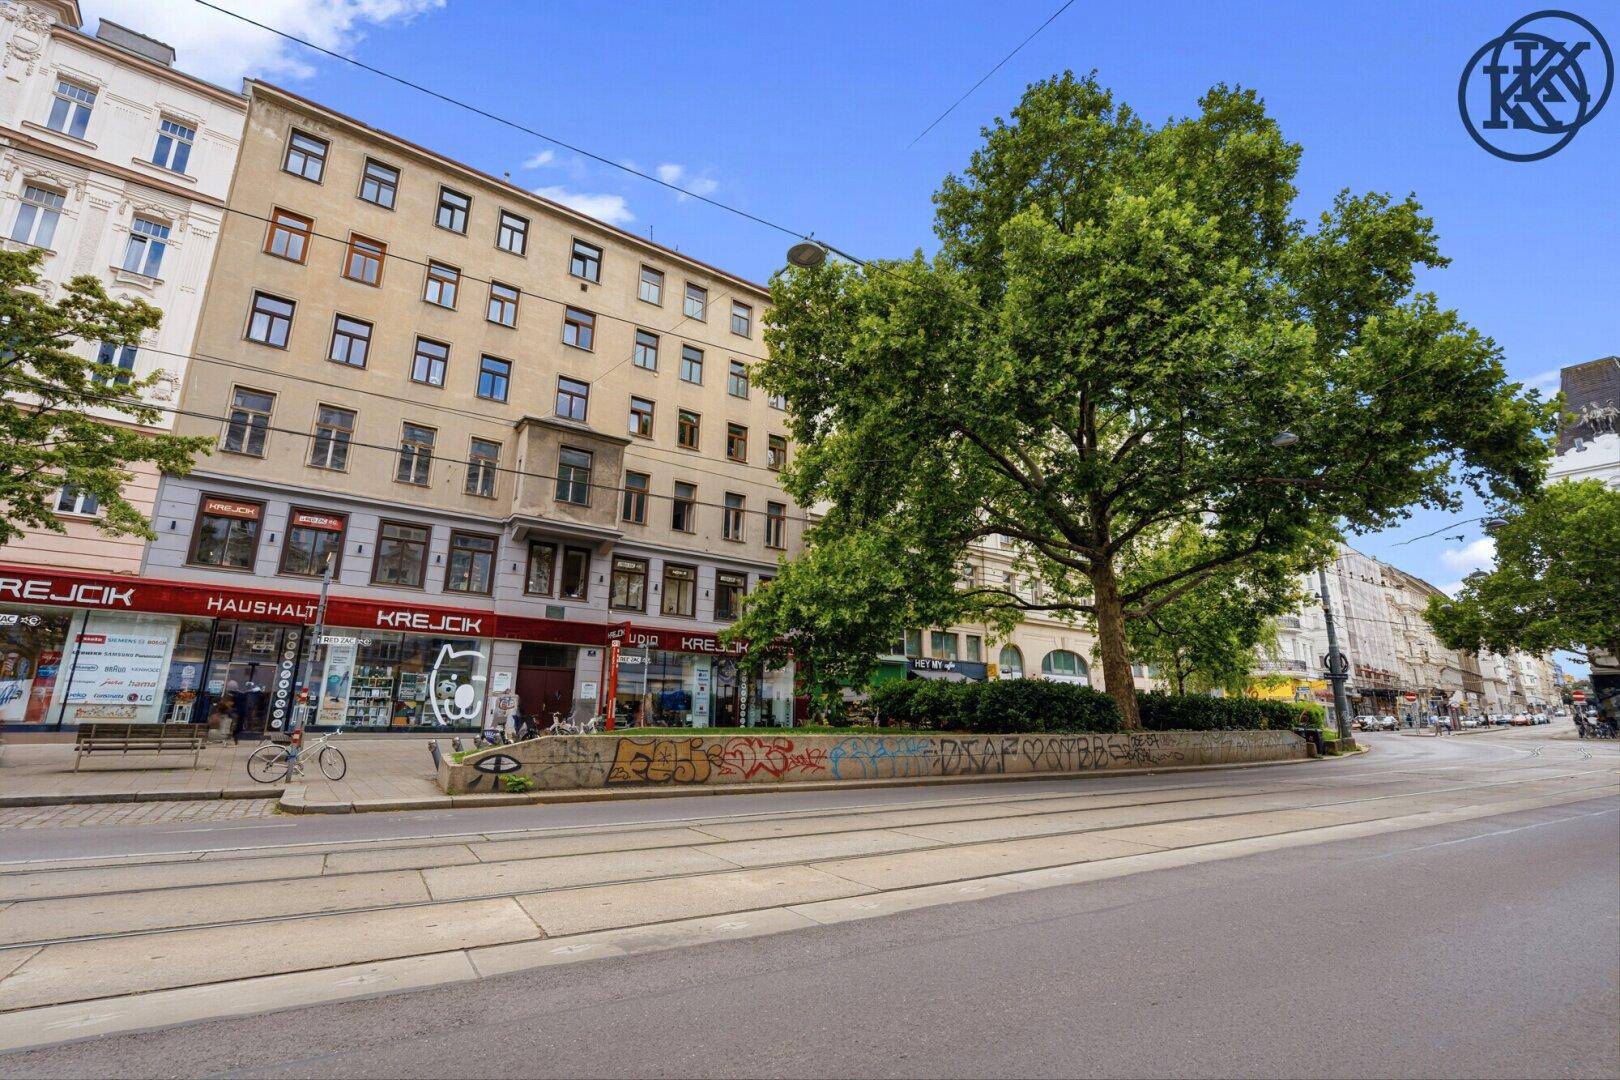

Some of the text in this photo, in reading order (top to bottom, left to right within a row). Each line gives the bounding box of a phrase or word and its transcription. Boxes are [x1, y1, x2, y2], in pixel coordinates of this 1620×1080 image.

[208, 502, 256, 515] KREJCIK
[0, 577, 136, 607] REJCIK
[206, 597, 318, 618] HAUSHALT
[376, 610, 482, 633] KREJCIK
[323, 636, 340, 644] RED
[628, 633, 658, 646] UDIO
[914, 659, 929, 668] HEY
[931, 660, 943, 669] MY
[128, 680, 156, 688] hama
[140, 694, 153, 702] LG
